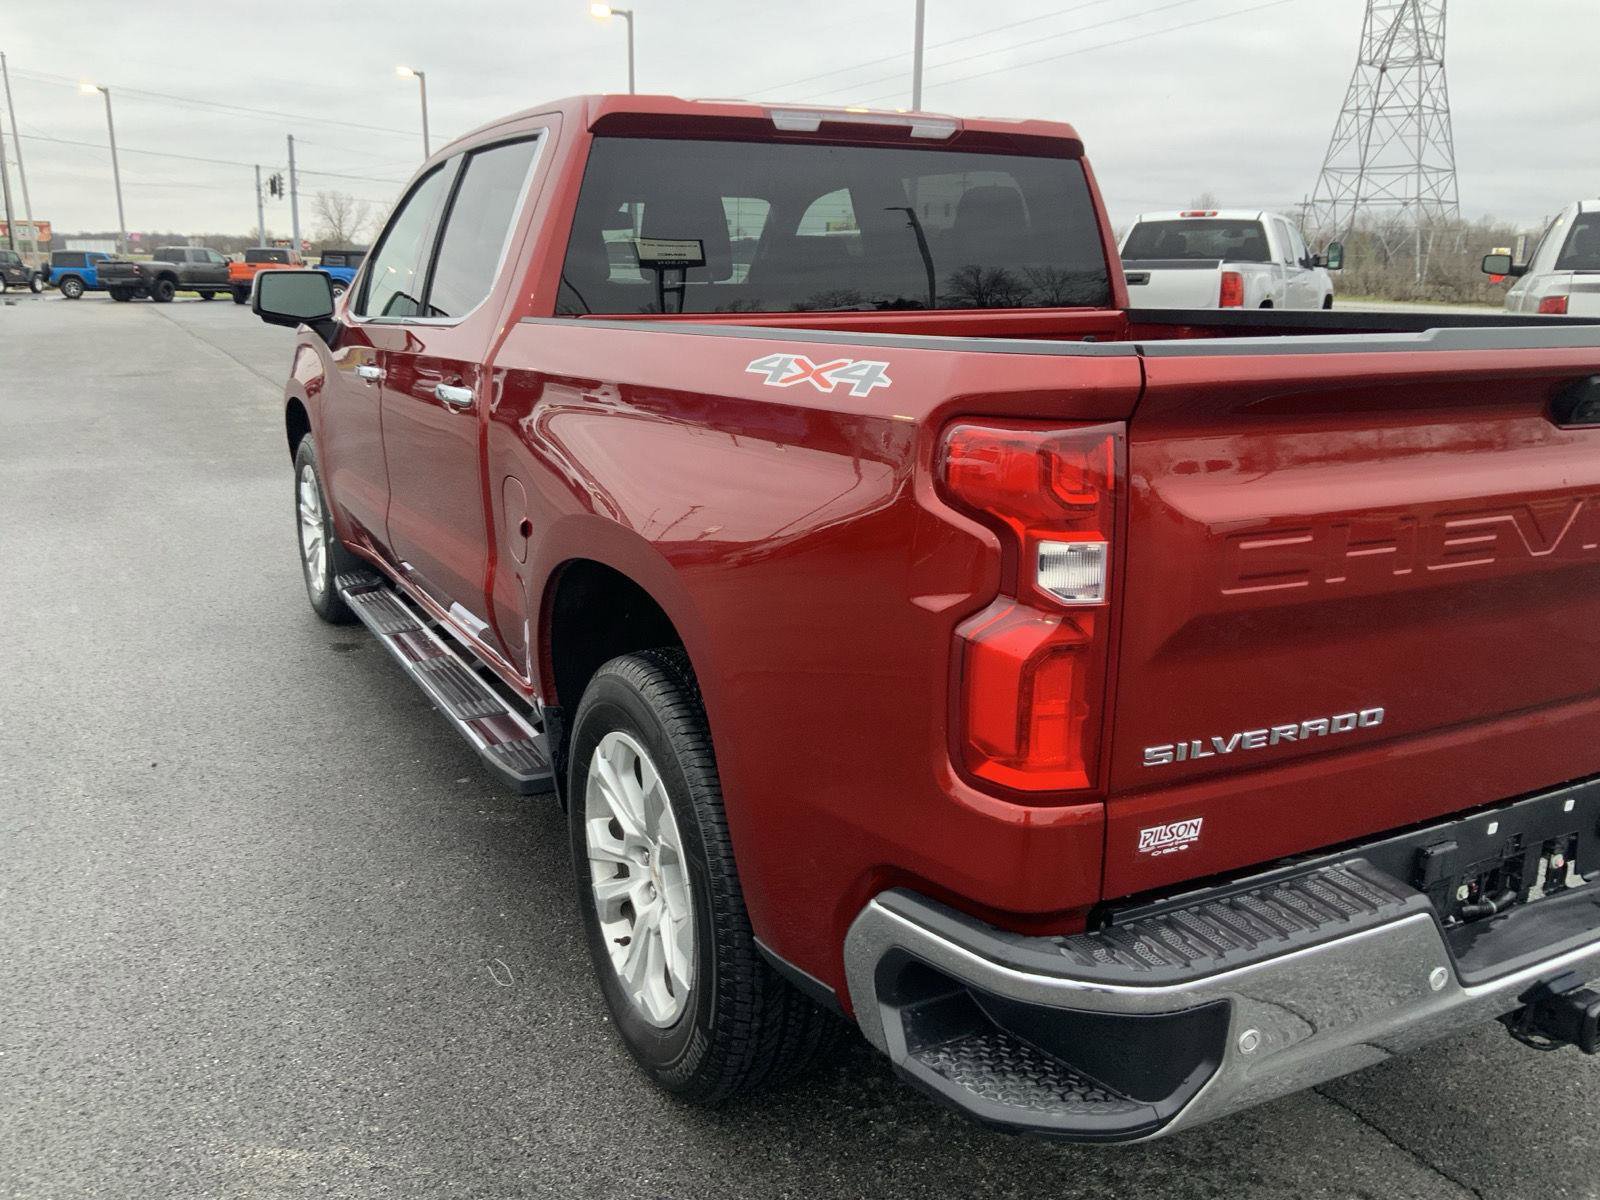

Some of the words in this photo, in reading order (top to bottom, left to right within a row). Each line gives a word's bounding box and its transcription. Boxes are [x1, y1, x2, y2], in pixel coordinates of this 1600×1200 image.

[1221, 495, 1600, 595] CHEV
[1143, 707, 1385, 767] SILVERADO
[1140, 819, 1201, 846] PILSON
